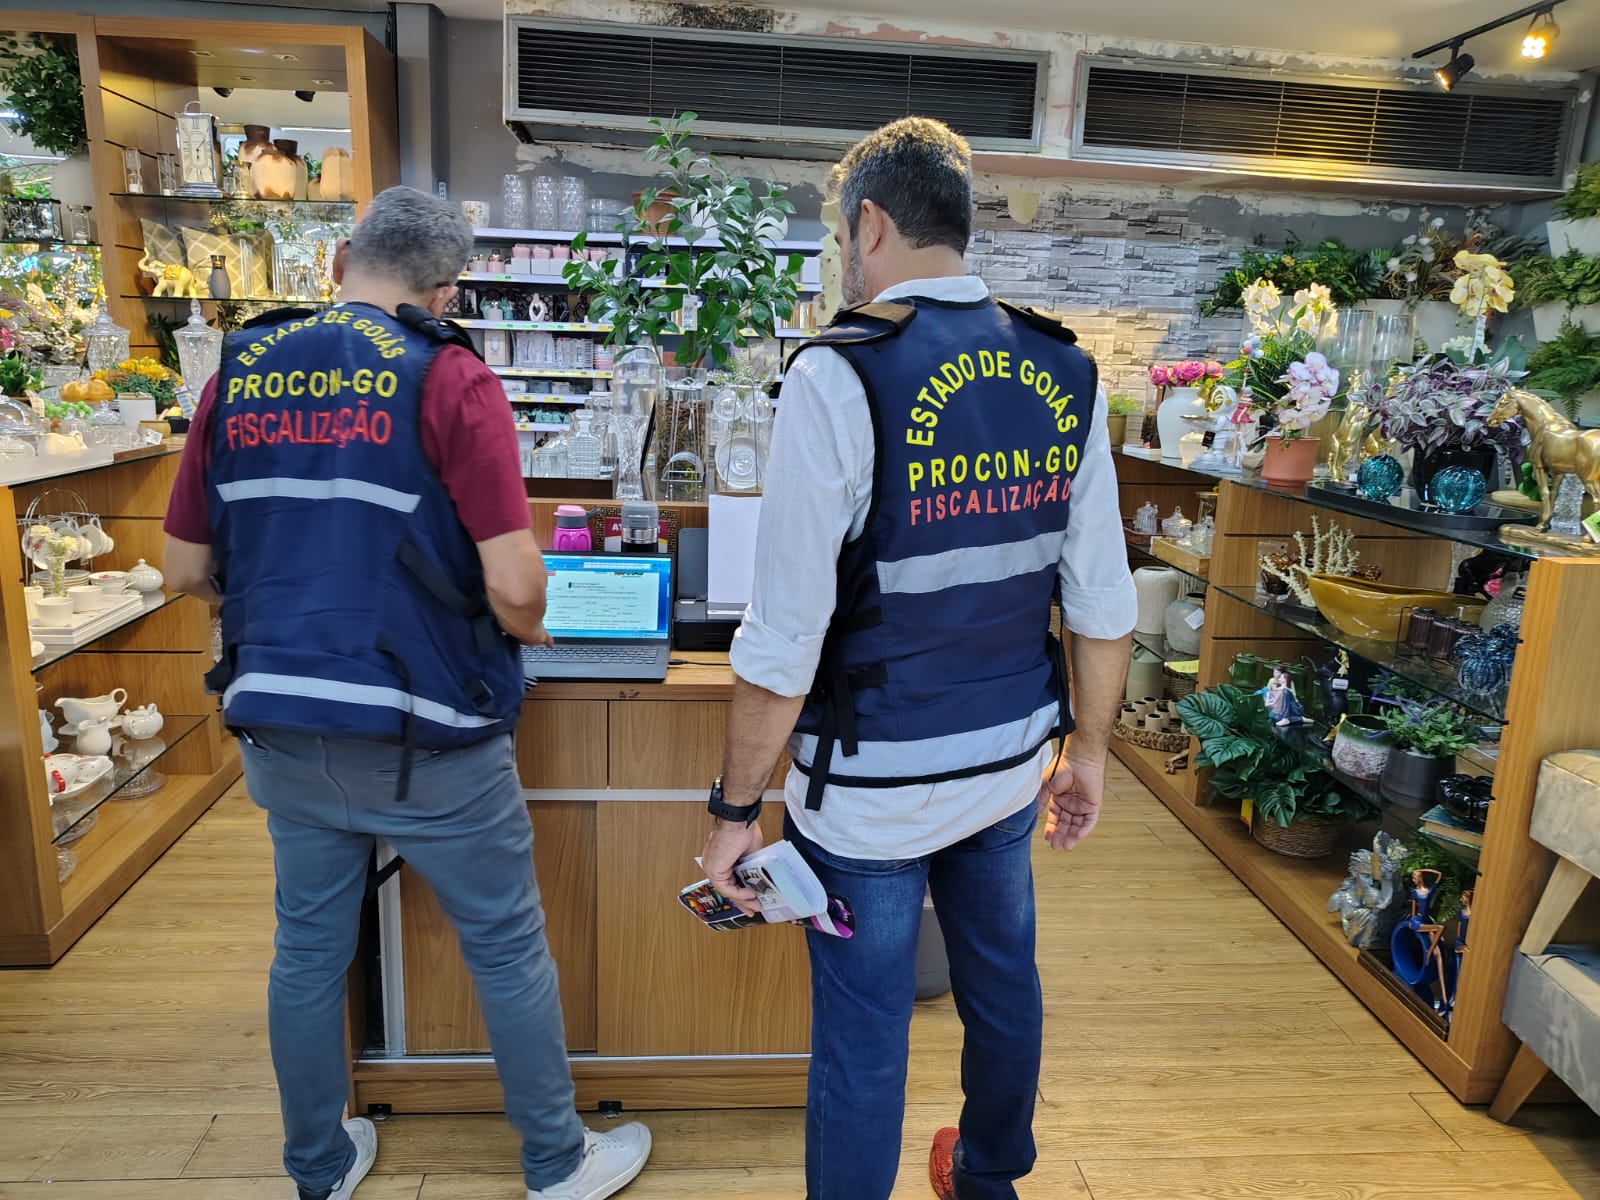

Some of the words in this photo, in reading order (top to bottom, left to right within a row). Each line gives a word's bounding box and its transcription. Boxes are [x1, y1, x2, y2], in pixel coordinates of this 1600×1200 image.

[236, 316, 319, 367] ESTADO
[322, 309, 355, 324] DE
[352, 318, 406, 360] GOIÁS
[906, 352, 976, 447] ESTADO
[978, 350, 1012, 379] DE
[1019, 359, 1079, 433] GOIÁS
[910, 474, 1072, 526] FISCALIZAÇÃO
